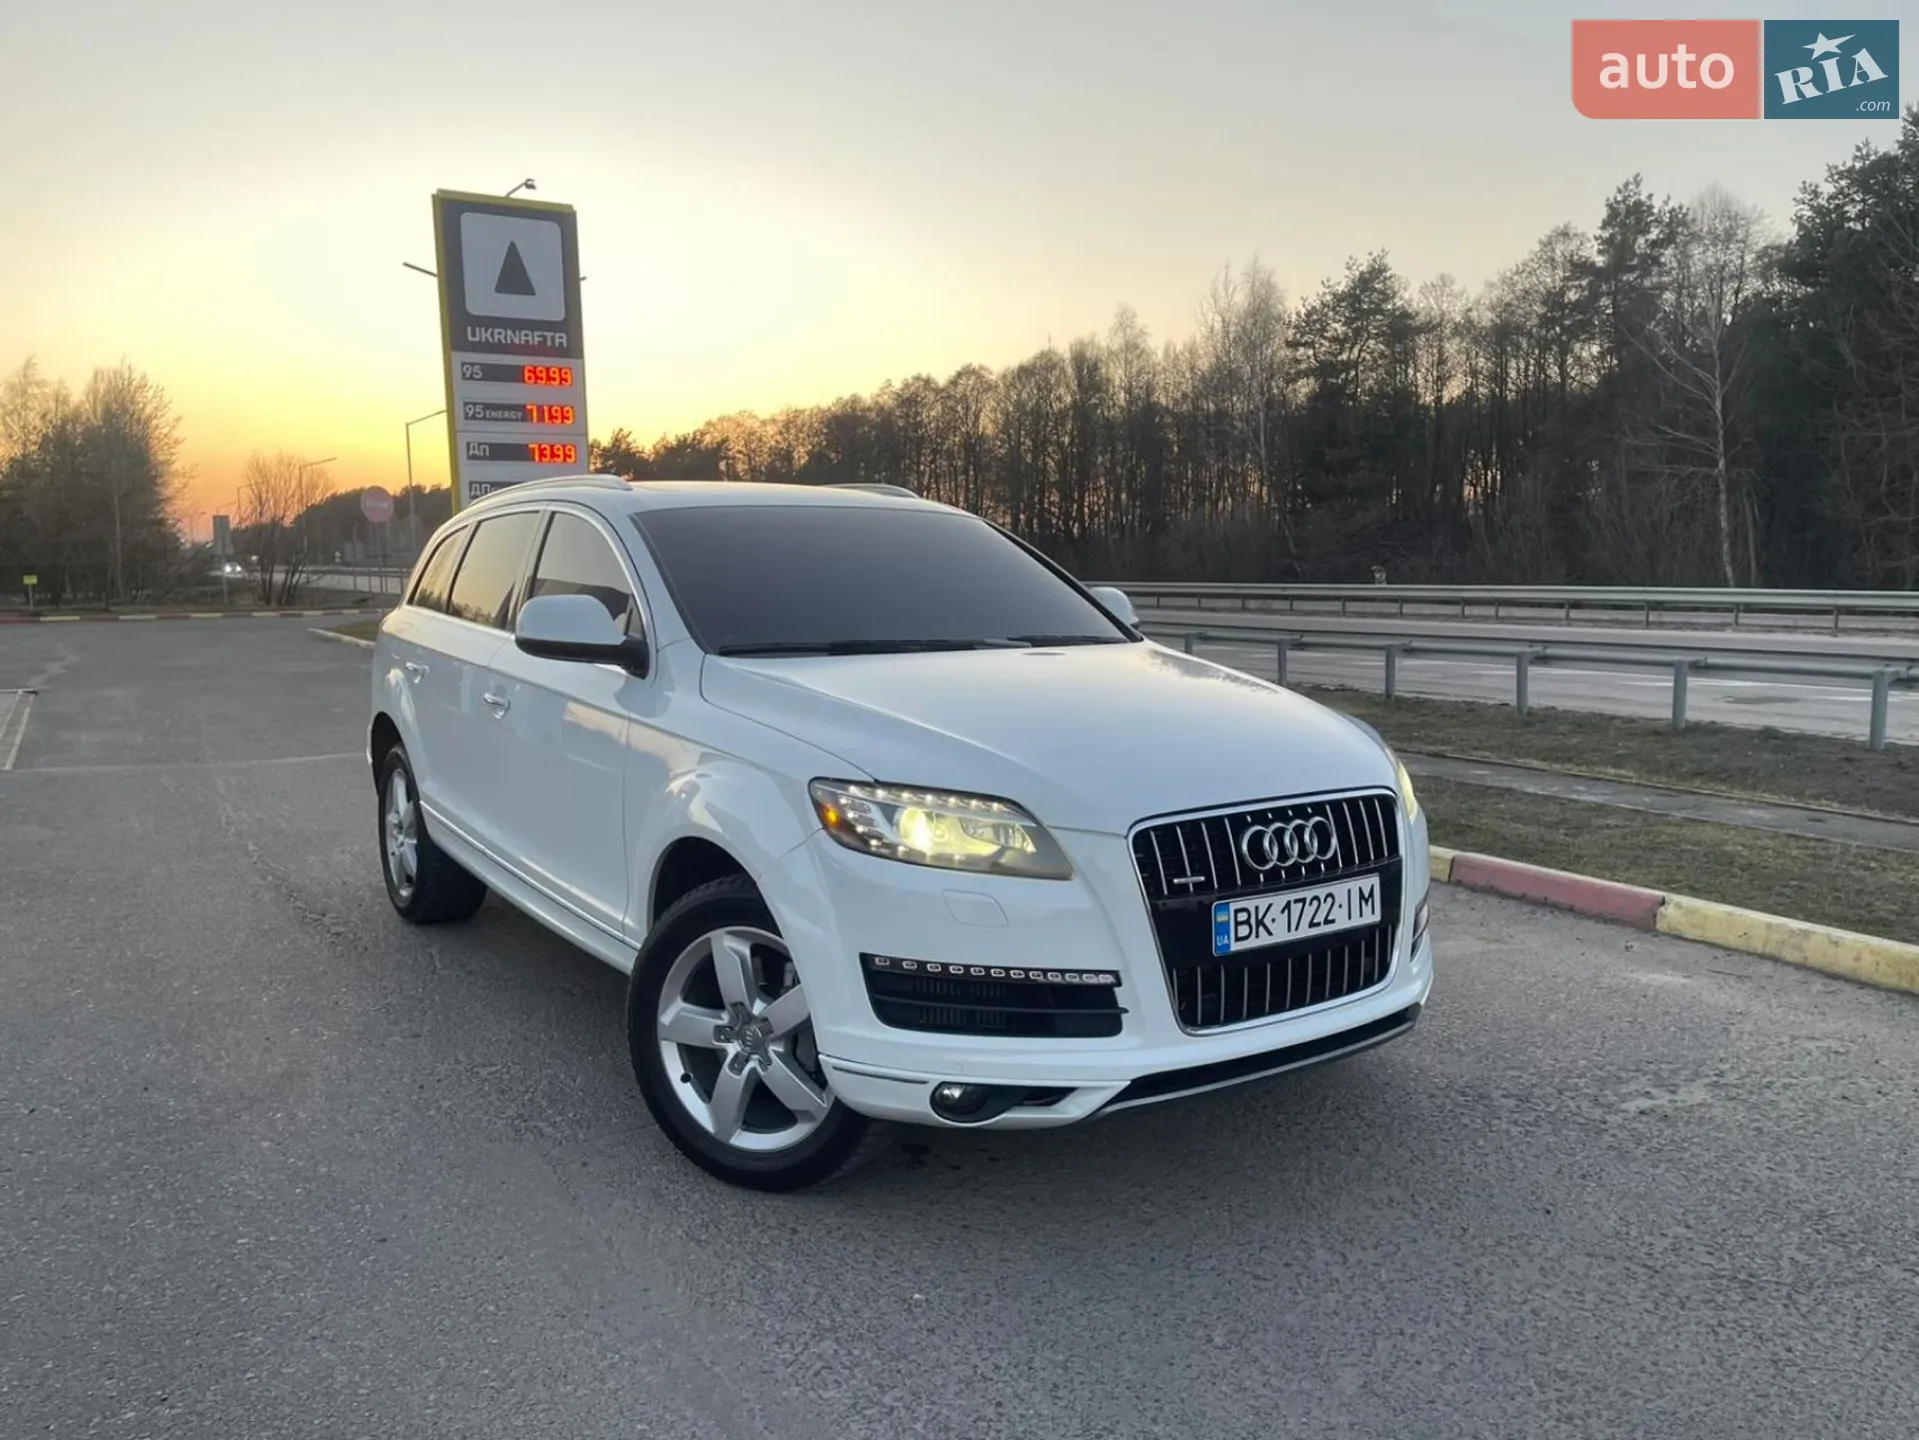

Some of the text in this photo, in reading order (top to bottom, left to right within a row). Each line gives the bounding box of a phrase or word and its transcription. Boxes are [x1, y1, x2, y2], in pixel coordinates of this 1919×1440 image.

[466, 326, 567, 347] UKRNAFTA
[462, 365, 482, 379] 95
[465, 404, 484, 419] 95
[485, 410, 523, 420] ENERGY
[1216, 935, 1230, 946] UA
